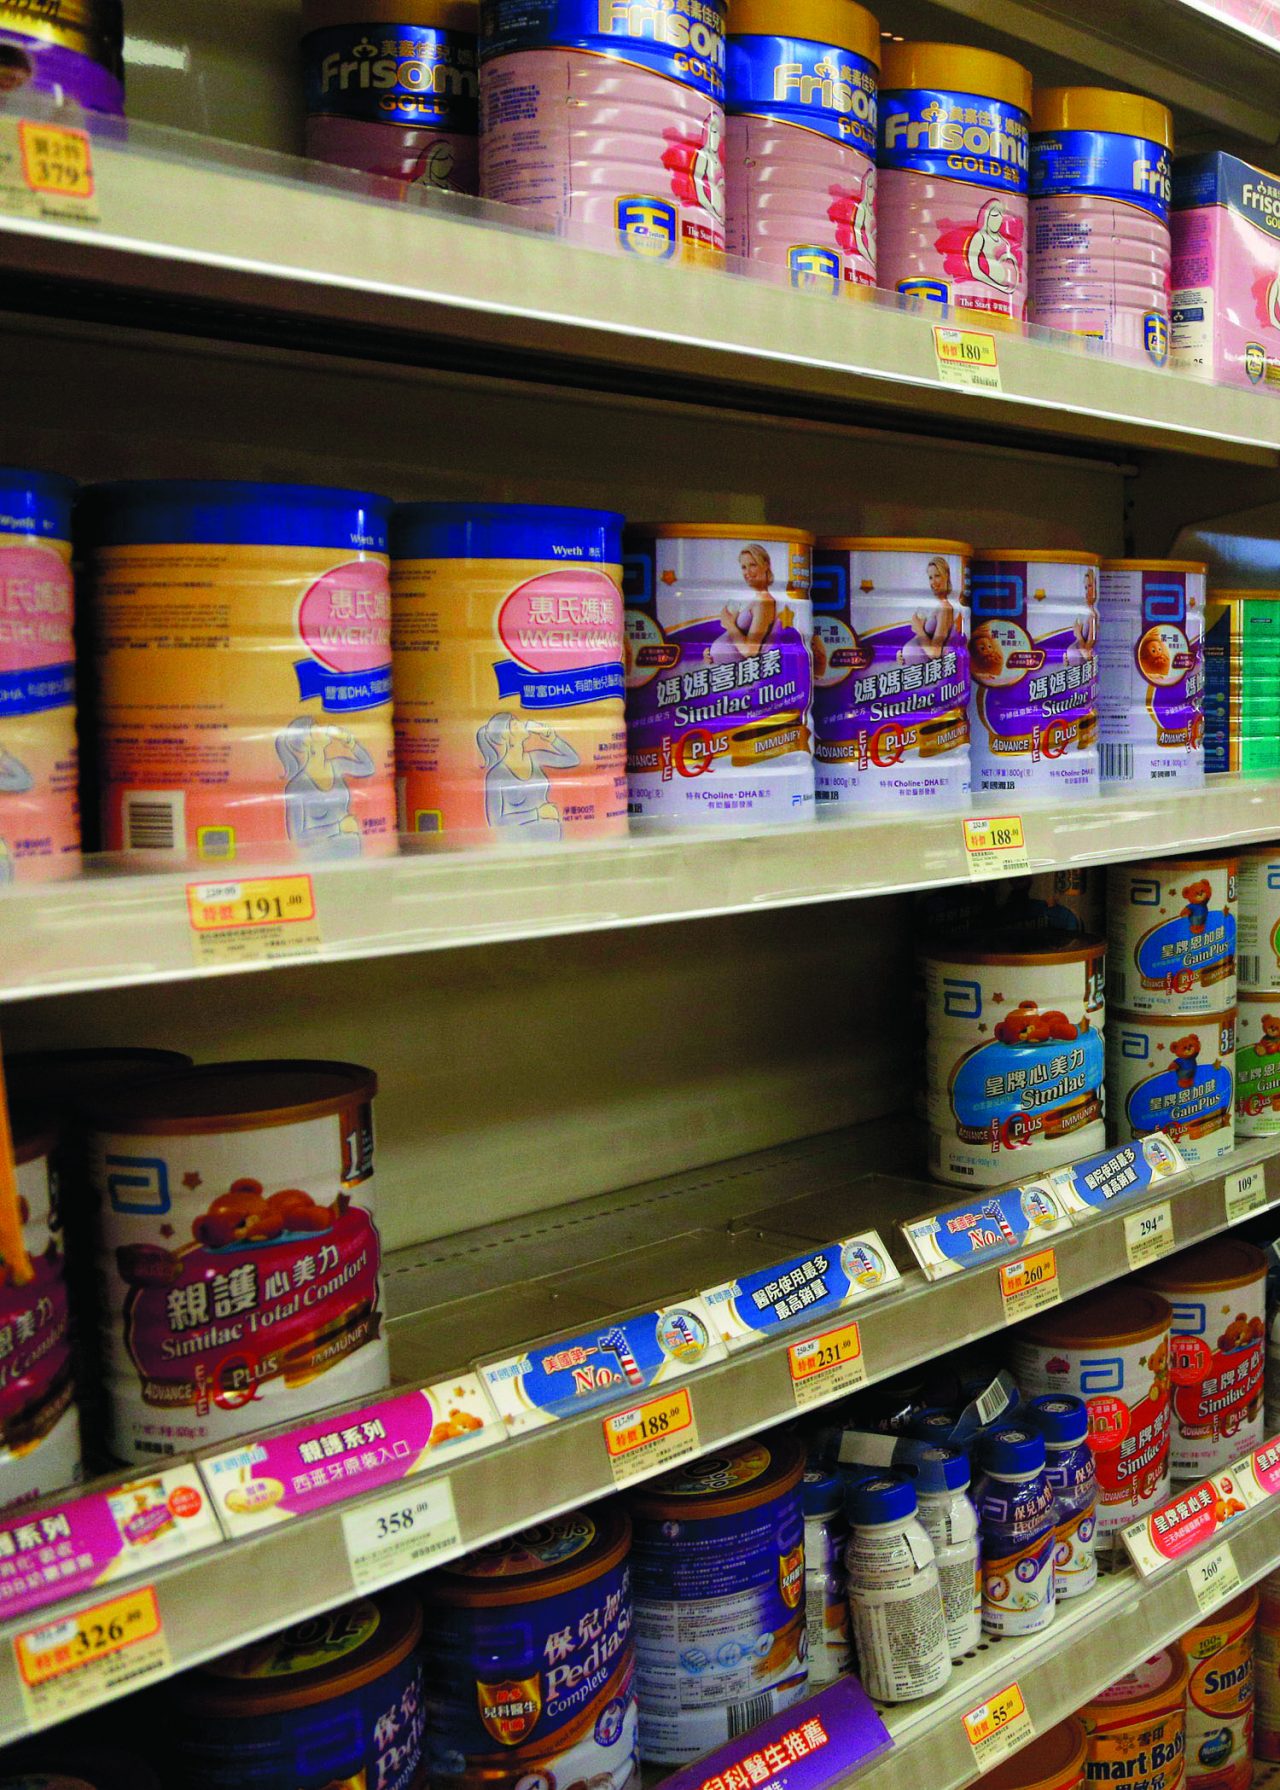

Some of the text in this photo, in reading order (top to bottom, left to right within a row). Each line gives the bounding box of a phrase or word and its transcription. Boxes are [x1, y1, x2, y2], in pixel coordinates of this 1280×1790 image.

[947, 155, 1001, 177] GOLD
[553, 545, 583, 557] Wyeth
[519, 630, 582, 649] WYETH
[657, 648, 782, 708] 媽媽喜康素
[854, 652, 957, 704] 媽媽喜康素
[674, 680, 796, 727] Similac Mom
[869, 692, 936, 723] Similac
[1042, 692, 1089, 718] Similac
[692, 736, 729, 760] PLUS
[755, 730, 801, 753] IMMUNIFY
[816, 744, 854, 758] ADVANCE
[886, 730, 917, 751] PLUS
[992, 738, 1029, 751] ADVANCE
[1054, 724, 1077, 744] PLUS
[985, 1048, 1086, 1098] 皇牌心美力
[1021, 1072, 1086, 1111] Similac
[1015, 1117, 1042, 1136] PLUS
[1062, 1105, 1098, 1129] IMMUNIFY
[1084, 1147, 1137, 1191] 醫院使用最多
[1101, 1166, 1139, 1199] 最高銷量
[751, 1255, 829, 1310] 醫院使用最多
[774, 1279, 829, 1321] 最高銷量
[161, 1252, 368, 1361] Similac Total Comfort
[311, 1323, 370, 1367] IMMUNIFY
[542, 1346, 598, 1375] 美國第一
[145, 1381, 192, 1401] ADVANCE
[232, 1356, 279, 1388] PLUS
[1198, 1384, 1248, 1418] Similac
[298, 1419, 387, 1464] 親護系列
[291, 1440, 411, 1495] 西班牙原裝入口
[1117, 1443, 1160, 1481] Similac
[1154, 1489, 1214, 1534] 皇牌愛心美
[484, 1700, 537, 1719] 兒科醫生
[546, 1667, 608, 1718] Complete
